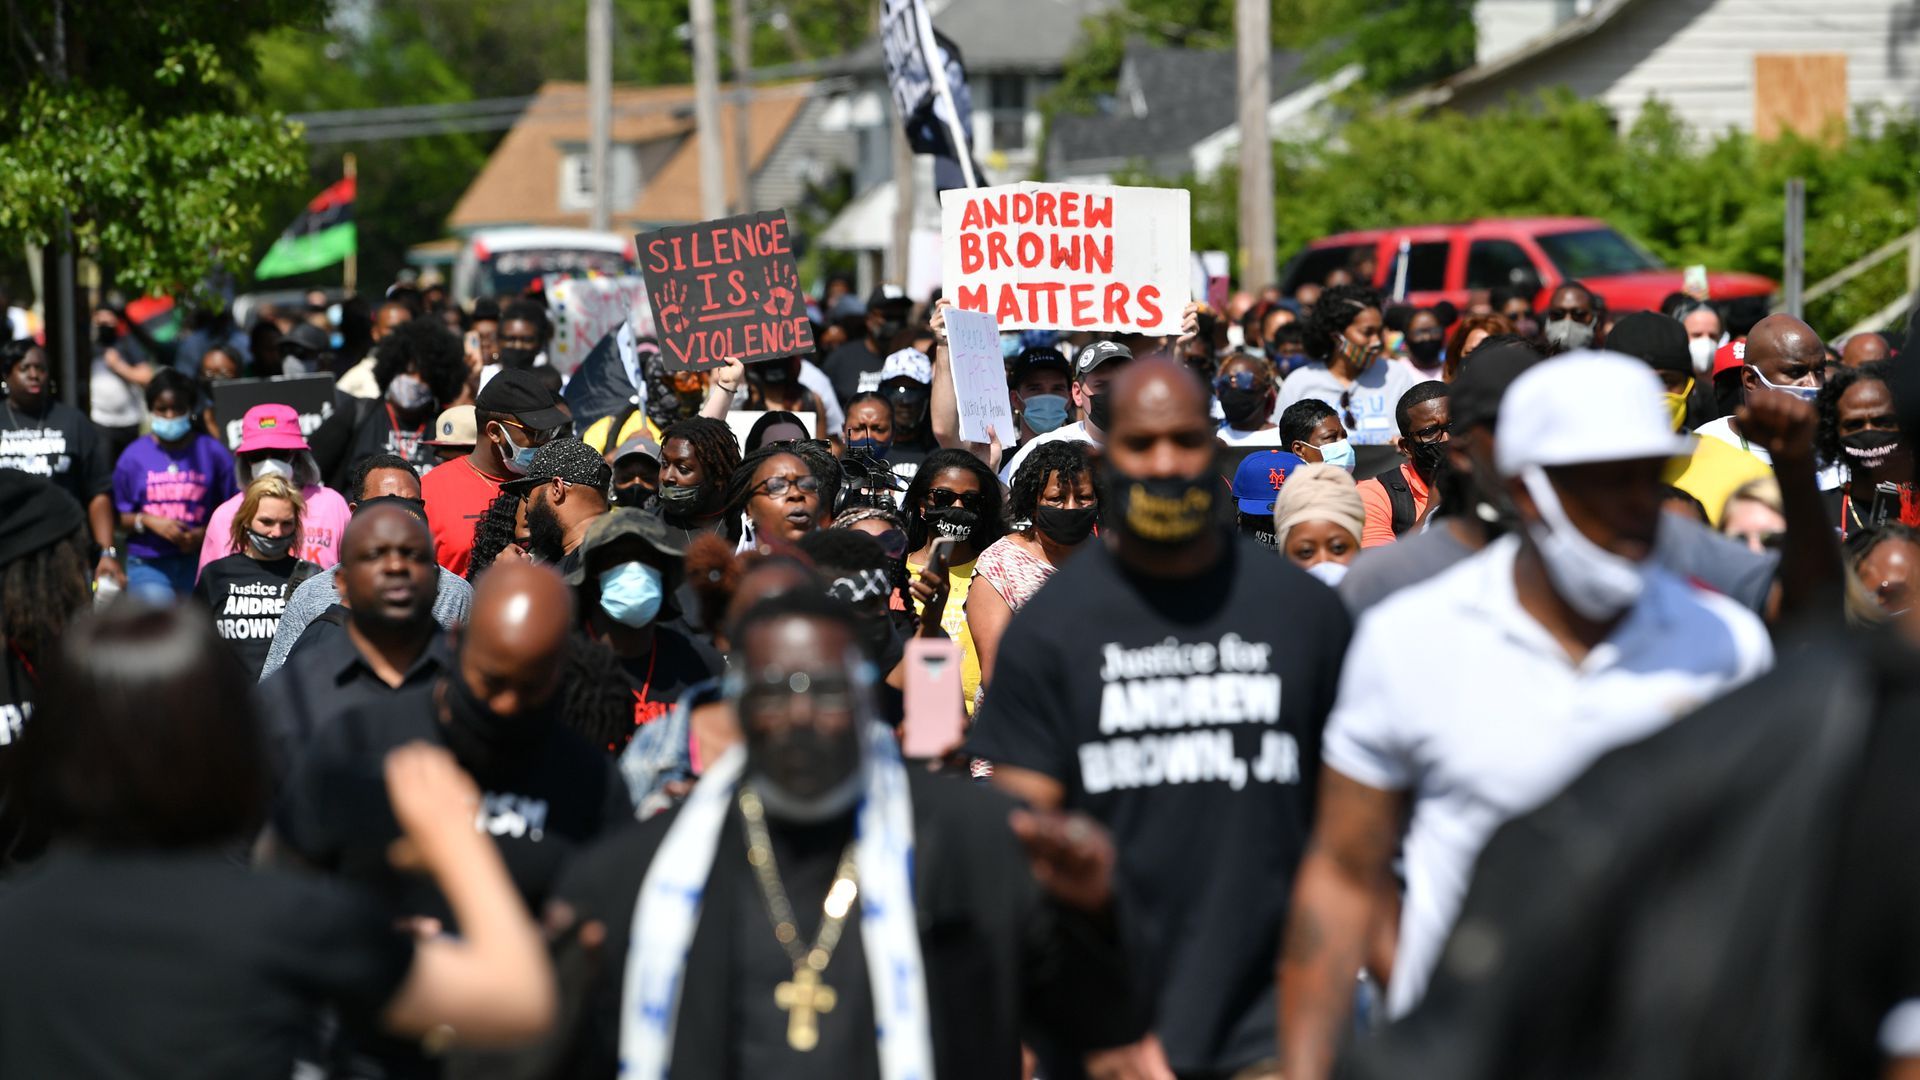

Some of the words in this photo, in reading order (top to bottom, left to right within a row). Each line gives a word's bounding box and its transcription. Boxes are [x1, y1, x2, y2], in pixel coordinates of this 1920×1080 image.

[960, 191, 1112, 231] ANDREW
[648, 218, 791, 273] SILENCE
[959, 231, 1114, 275] BROWN
[696, 269, 748, 311] IS
[957, 281, 1164, 328] MATTERS
[665, 316, 814, 364] VIOLENCE
[223, 595, 286, 615] ANDRE
[227, 581, 278, 596] Justice
[216, 618, 280, 639] BROWN
[1100, 636, 1217, 682] Justice
[1218, 632, 1272, 672] for
[1099, 672, 1280, 735] ANDREW
